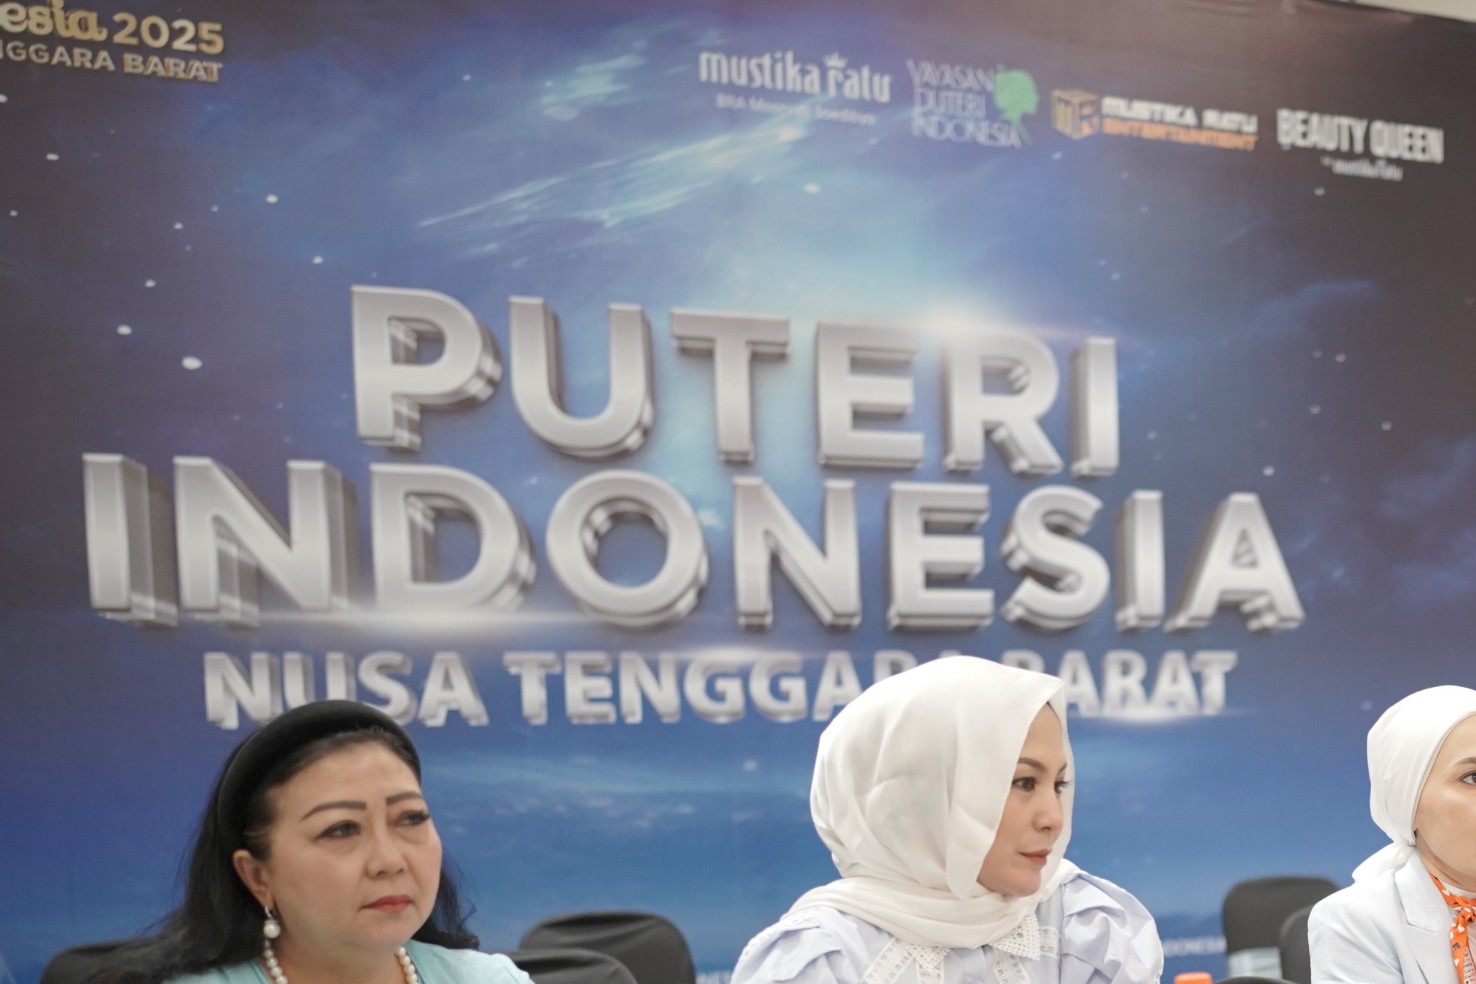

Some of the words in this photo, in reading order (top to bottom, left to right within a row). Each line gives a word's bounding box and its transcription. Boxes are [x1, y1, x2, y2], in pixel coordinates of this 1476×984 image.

[0, 39, 115, 71] GGARA
[123, 52, 223, 83] BARAT
[112, 12, 224, 55] 2025
[700, 50, 821, 94] mustika
[826, 66, 892, 104] ratu
[1276, 107, 1368, 154] BEAUTY
[1369, 119, 1445, 164] QUEEN
[351, 284, 1121, 477] PUTERI
[82, 452, 1306, 631] INDONESIA
[202, 649, 490, 731] NUSA
